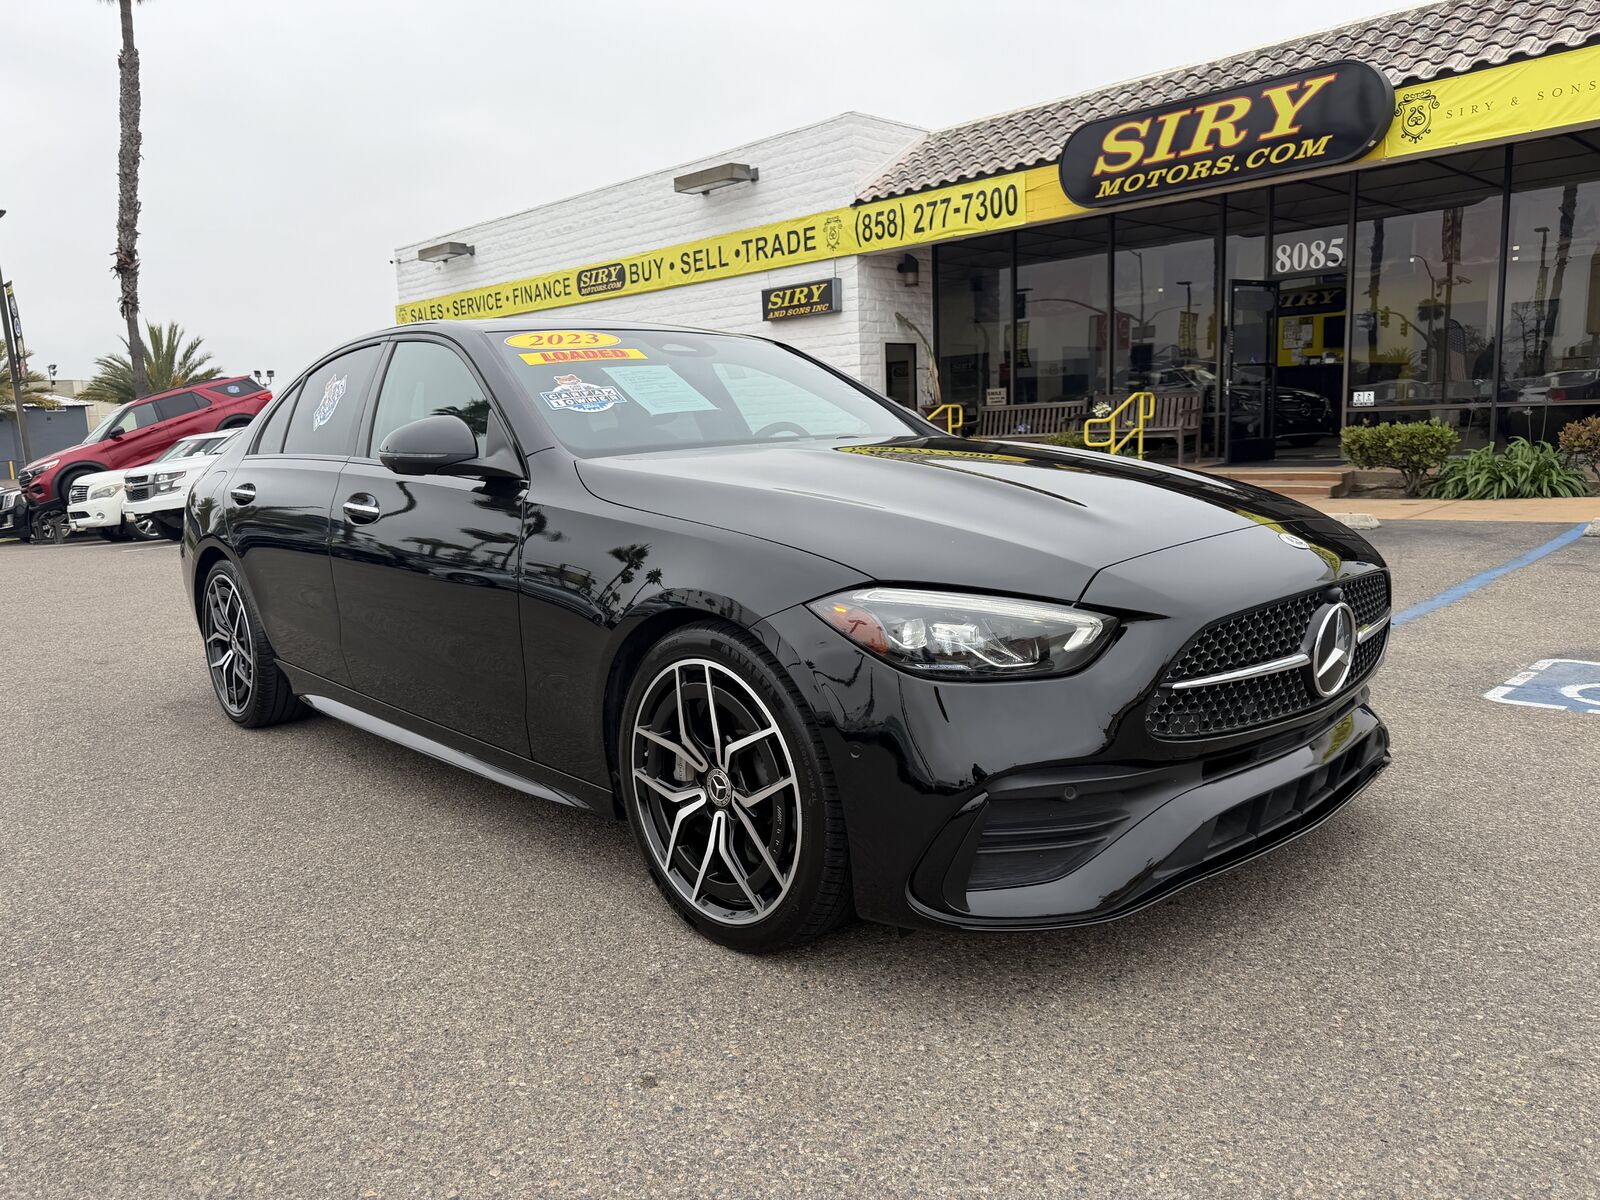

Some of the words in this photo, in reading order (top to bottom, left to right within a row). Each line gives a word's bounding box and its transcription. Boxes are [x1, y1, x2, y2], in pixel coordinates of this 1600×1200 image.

[1446, 101, 1494, 119] SIRY
[1510, 96, 1519, 106] &
[1537, 80, 1597, 101] SONS
[1092, 72, 1338, 177] SIRY
[1095, 135, 1333, 198] MOTORS.COM
[854, 203, 905, 248] (858)
[913, 184, 1019, 234] 277-7300
[629, 257, 664, 285] BUY
[681, 245, 729, 275] SELL
[742, 226, 817, 263] TRADE
[1275, 237, 1345, 273] 8085
[579, 265, 623, 289] SIRY
[410, 303, 444, 322] SALES
[452, 292, 503, 317] SERVICE
[512, 277, 572, 305] FINANCE
[767, 283, 828, 310] SIRY
[1279, 289, 1342, 308] IRY
[767, 309, 786, 319] AND
[787, 305, 811, 316] SONS
[811, 303, 829, 312] INC
[528, 333, 600, 347] 2023
[541, 349, 630, 363] LOADED
[548, 388, 617, 401] CARFAX
[565, 395, 620, 406] OWNER
